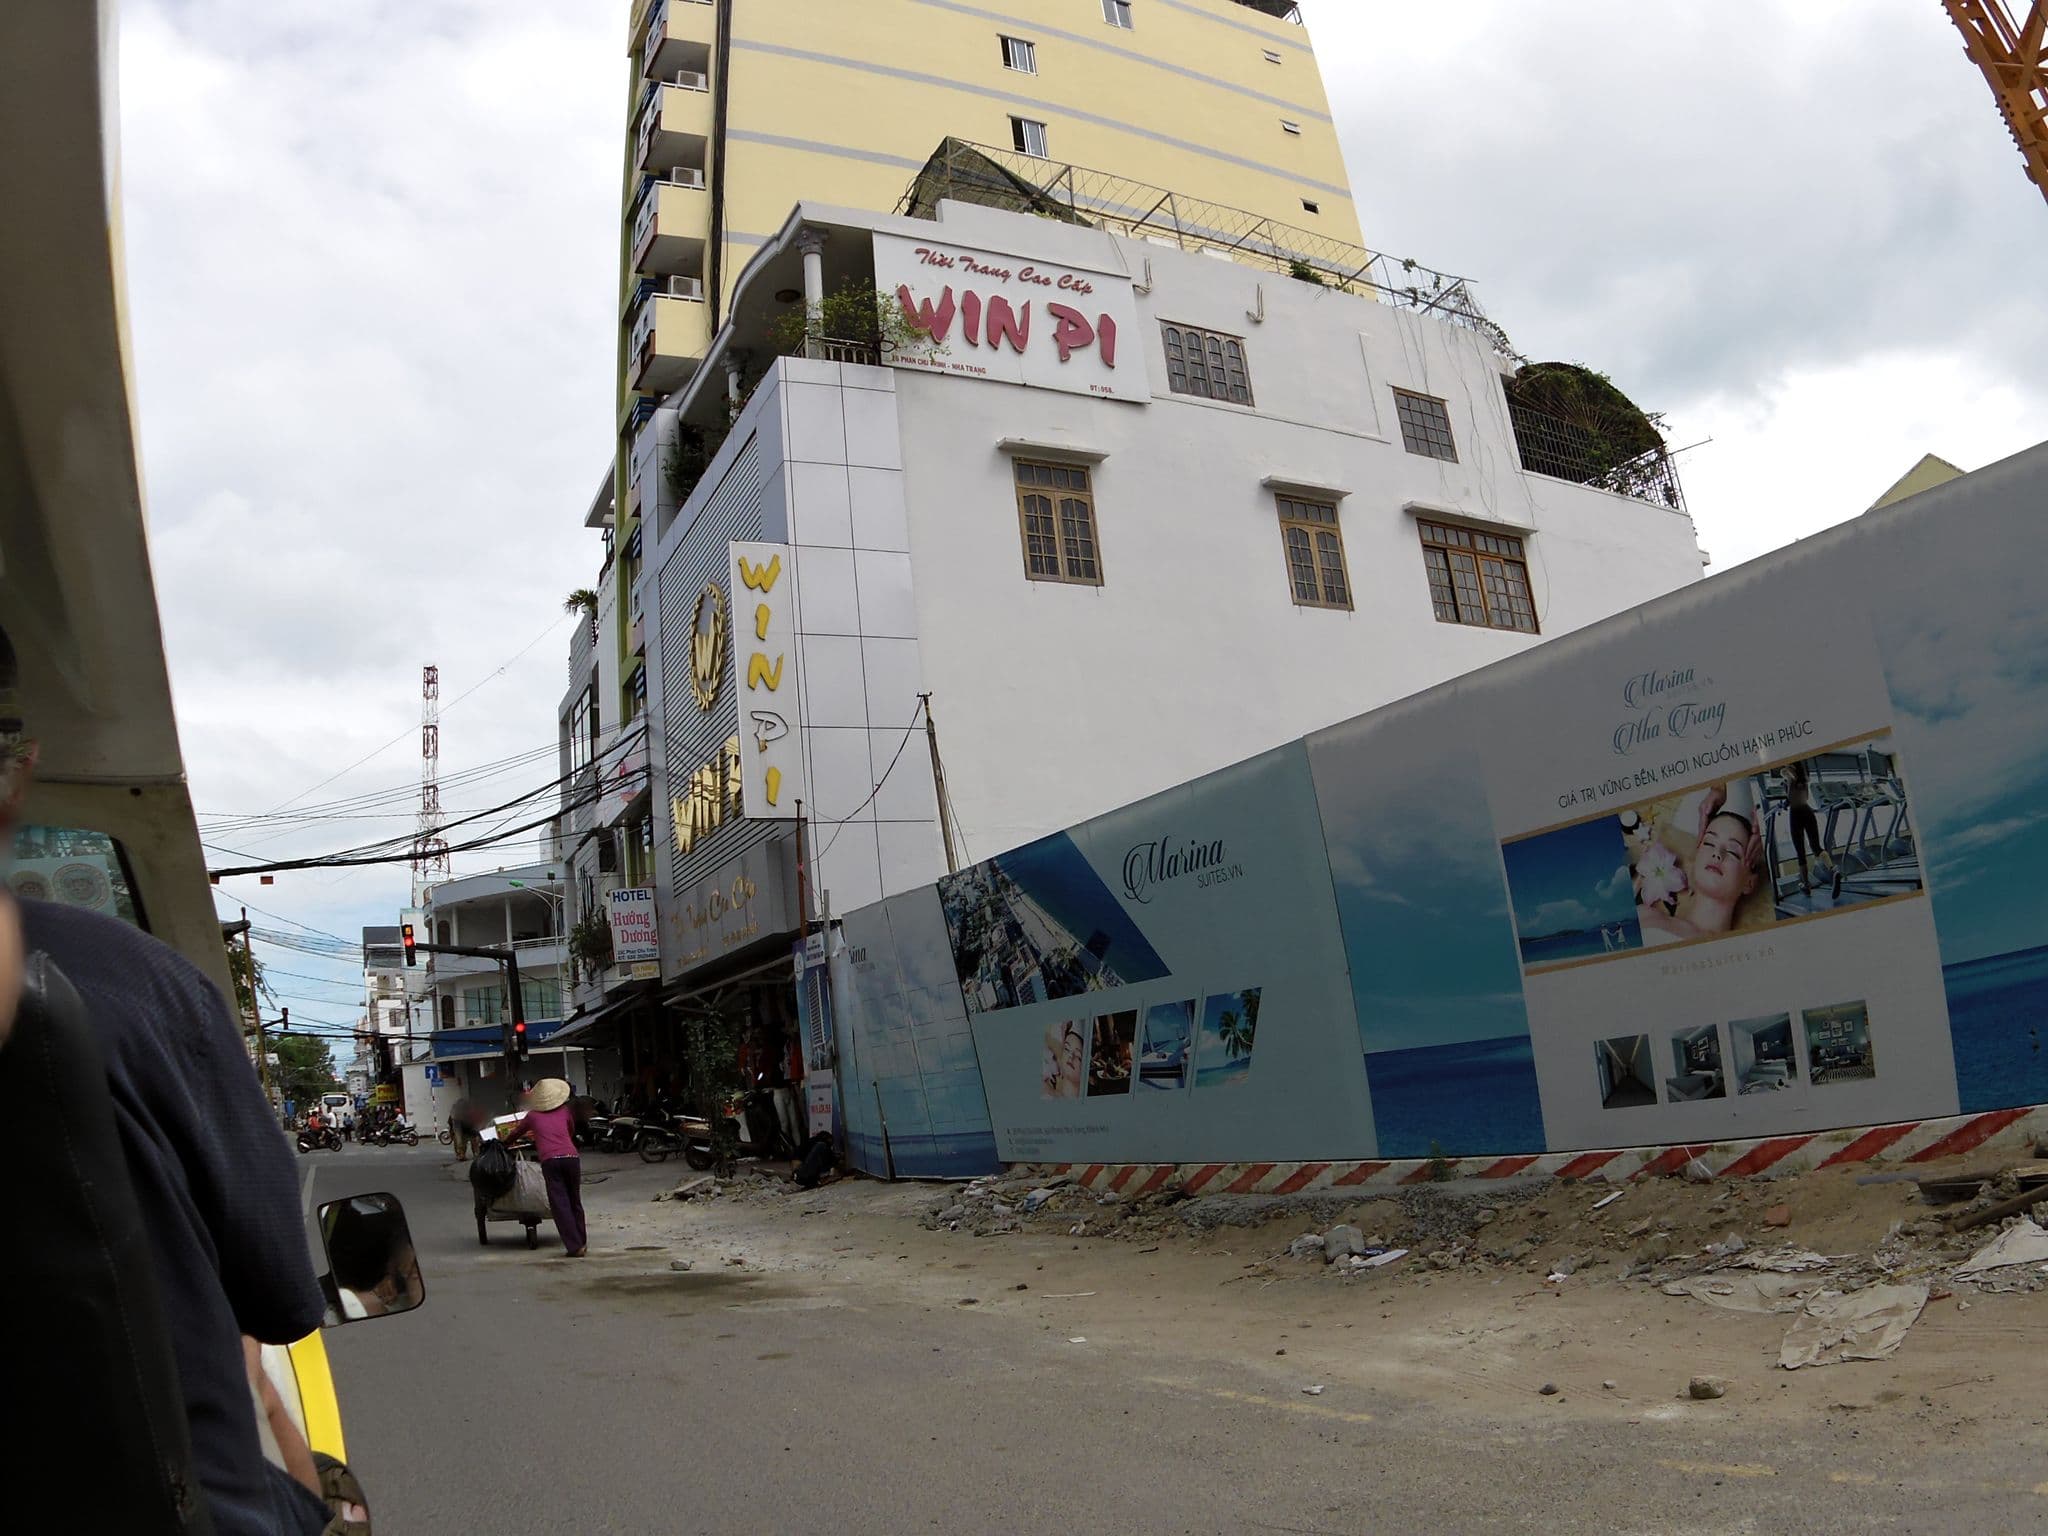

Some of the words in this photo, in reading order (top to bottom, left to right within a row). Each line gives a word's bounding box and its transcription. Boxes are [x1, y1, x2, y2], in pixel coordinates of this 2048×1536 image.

[959, 255, 1012, 284] Trang
[1018, 266, 1052, 286] Cao
[1057, 274, 1093, 296] Cấp
[897, 283, 1031, 354] WIN
[1048, 302, 1118, 369] PI
[1624, 668, 1695, 710] Marina
[1668, 702, 1726, 740] Trang
[1558, 789, 1578, 808] GIÁ
[1742, 732, 1776, 755] HẠNH
[1778, 720, 1813, 743] PHÚC
[1123, 835, 1226, 905] Marina
[1197, 863, 1244, 889] SUITES.VN
[612, 889, 652, 903] HOTEL
